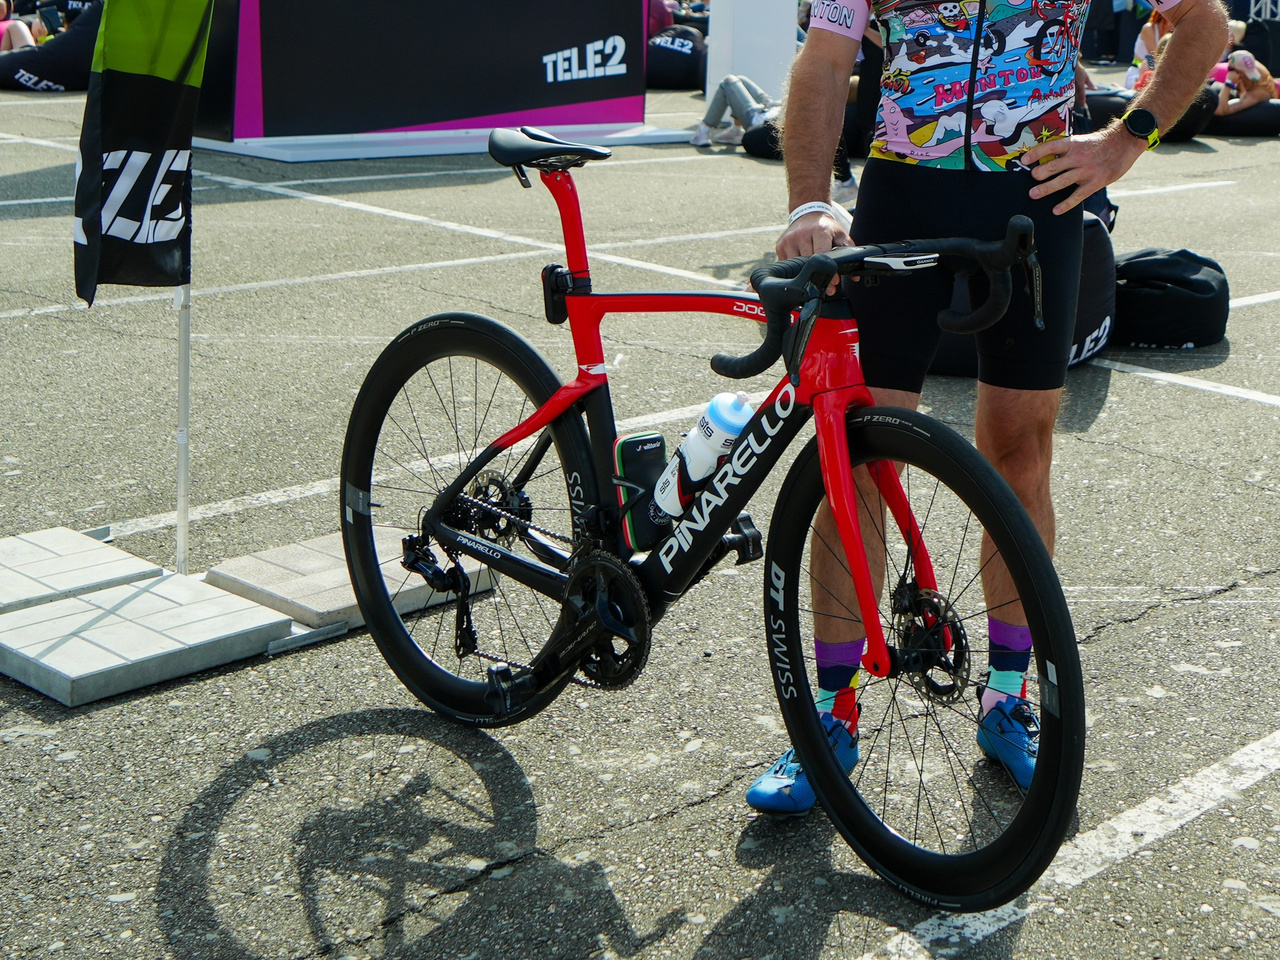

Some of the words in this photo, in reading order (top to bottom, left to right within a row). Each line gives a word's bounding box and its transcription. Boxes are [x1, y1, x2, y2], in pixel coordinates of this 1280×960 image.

[542, 35, 627, 83] TELE2
[934, 67, 1042, 107] MONTON
[1068, 315, 1111, 366] LE2
[872, 415, 901, 425] ZERO
[456, 535, 502, 559] PINARELLO
[769, 560, 787, 612] DT
[770, 614, 798, 700] SWISS
